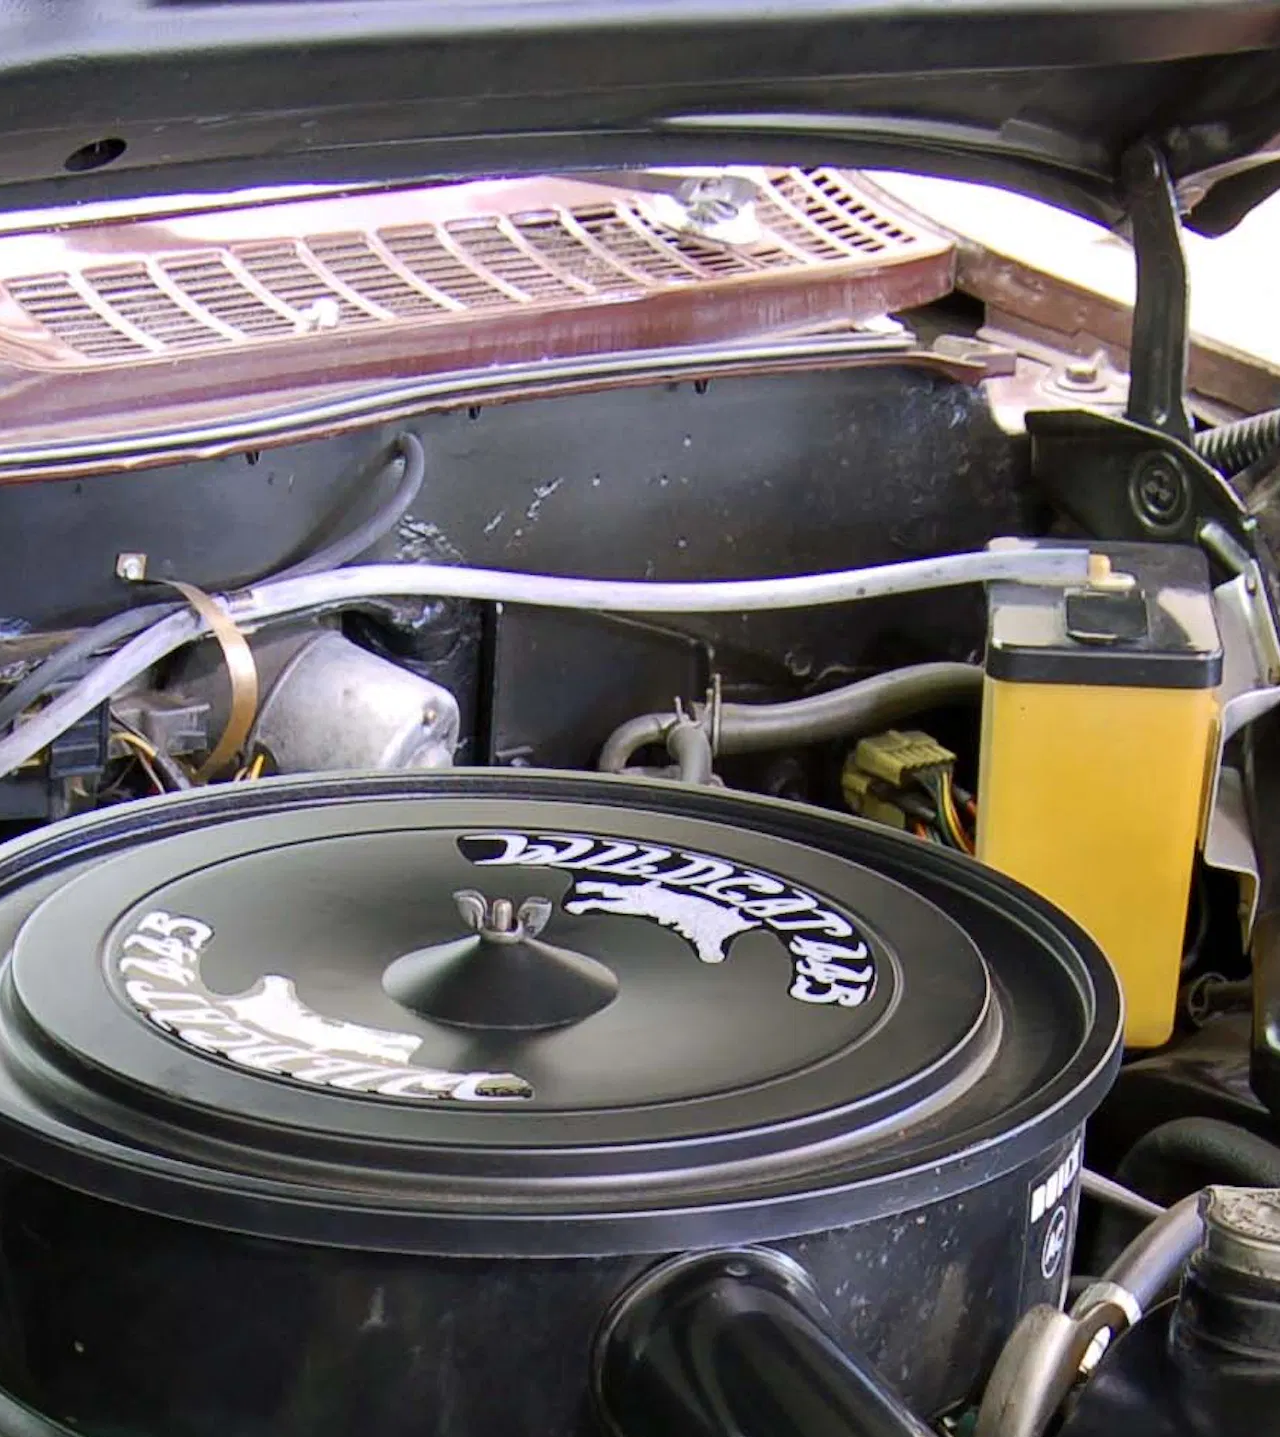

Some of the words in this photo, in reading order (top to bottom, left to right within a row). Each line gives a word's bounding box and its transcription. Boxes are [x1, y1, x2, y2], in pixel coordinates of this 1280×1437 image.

[121, 911, 214, 986] 445
[462, 833, 852, 938] WILDCAT
[788, 933, 872, 1008] 445
[124, 980, 535, 1100] WILDCAT
